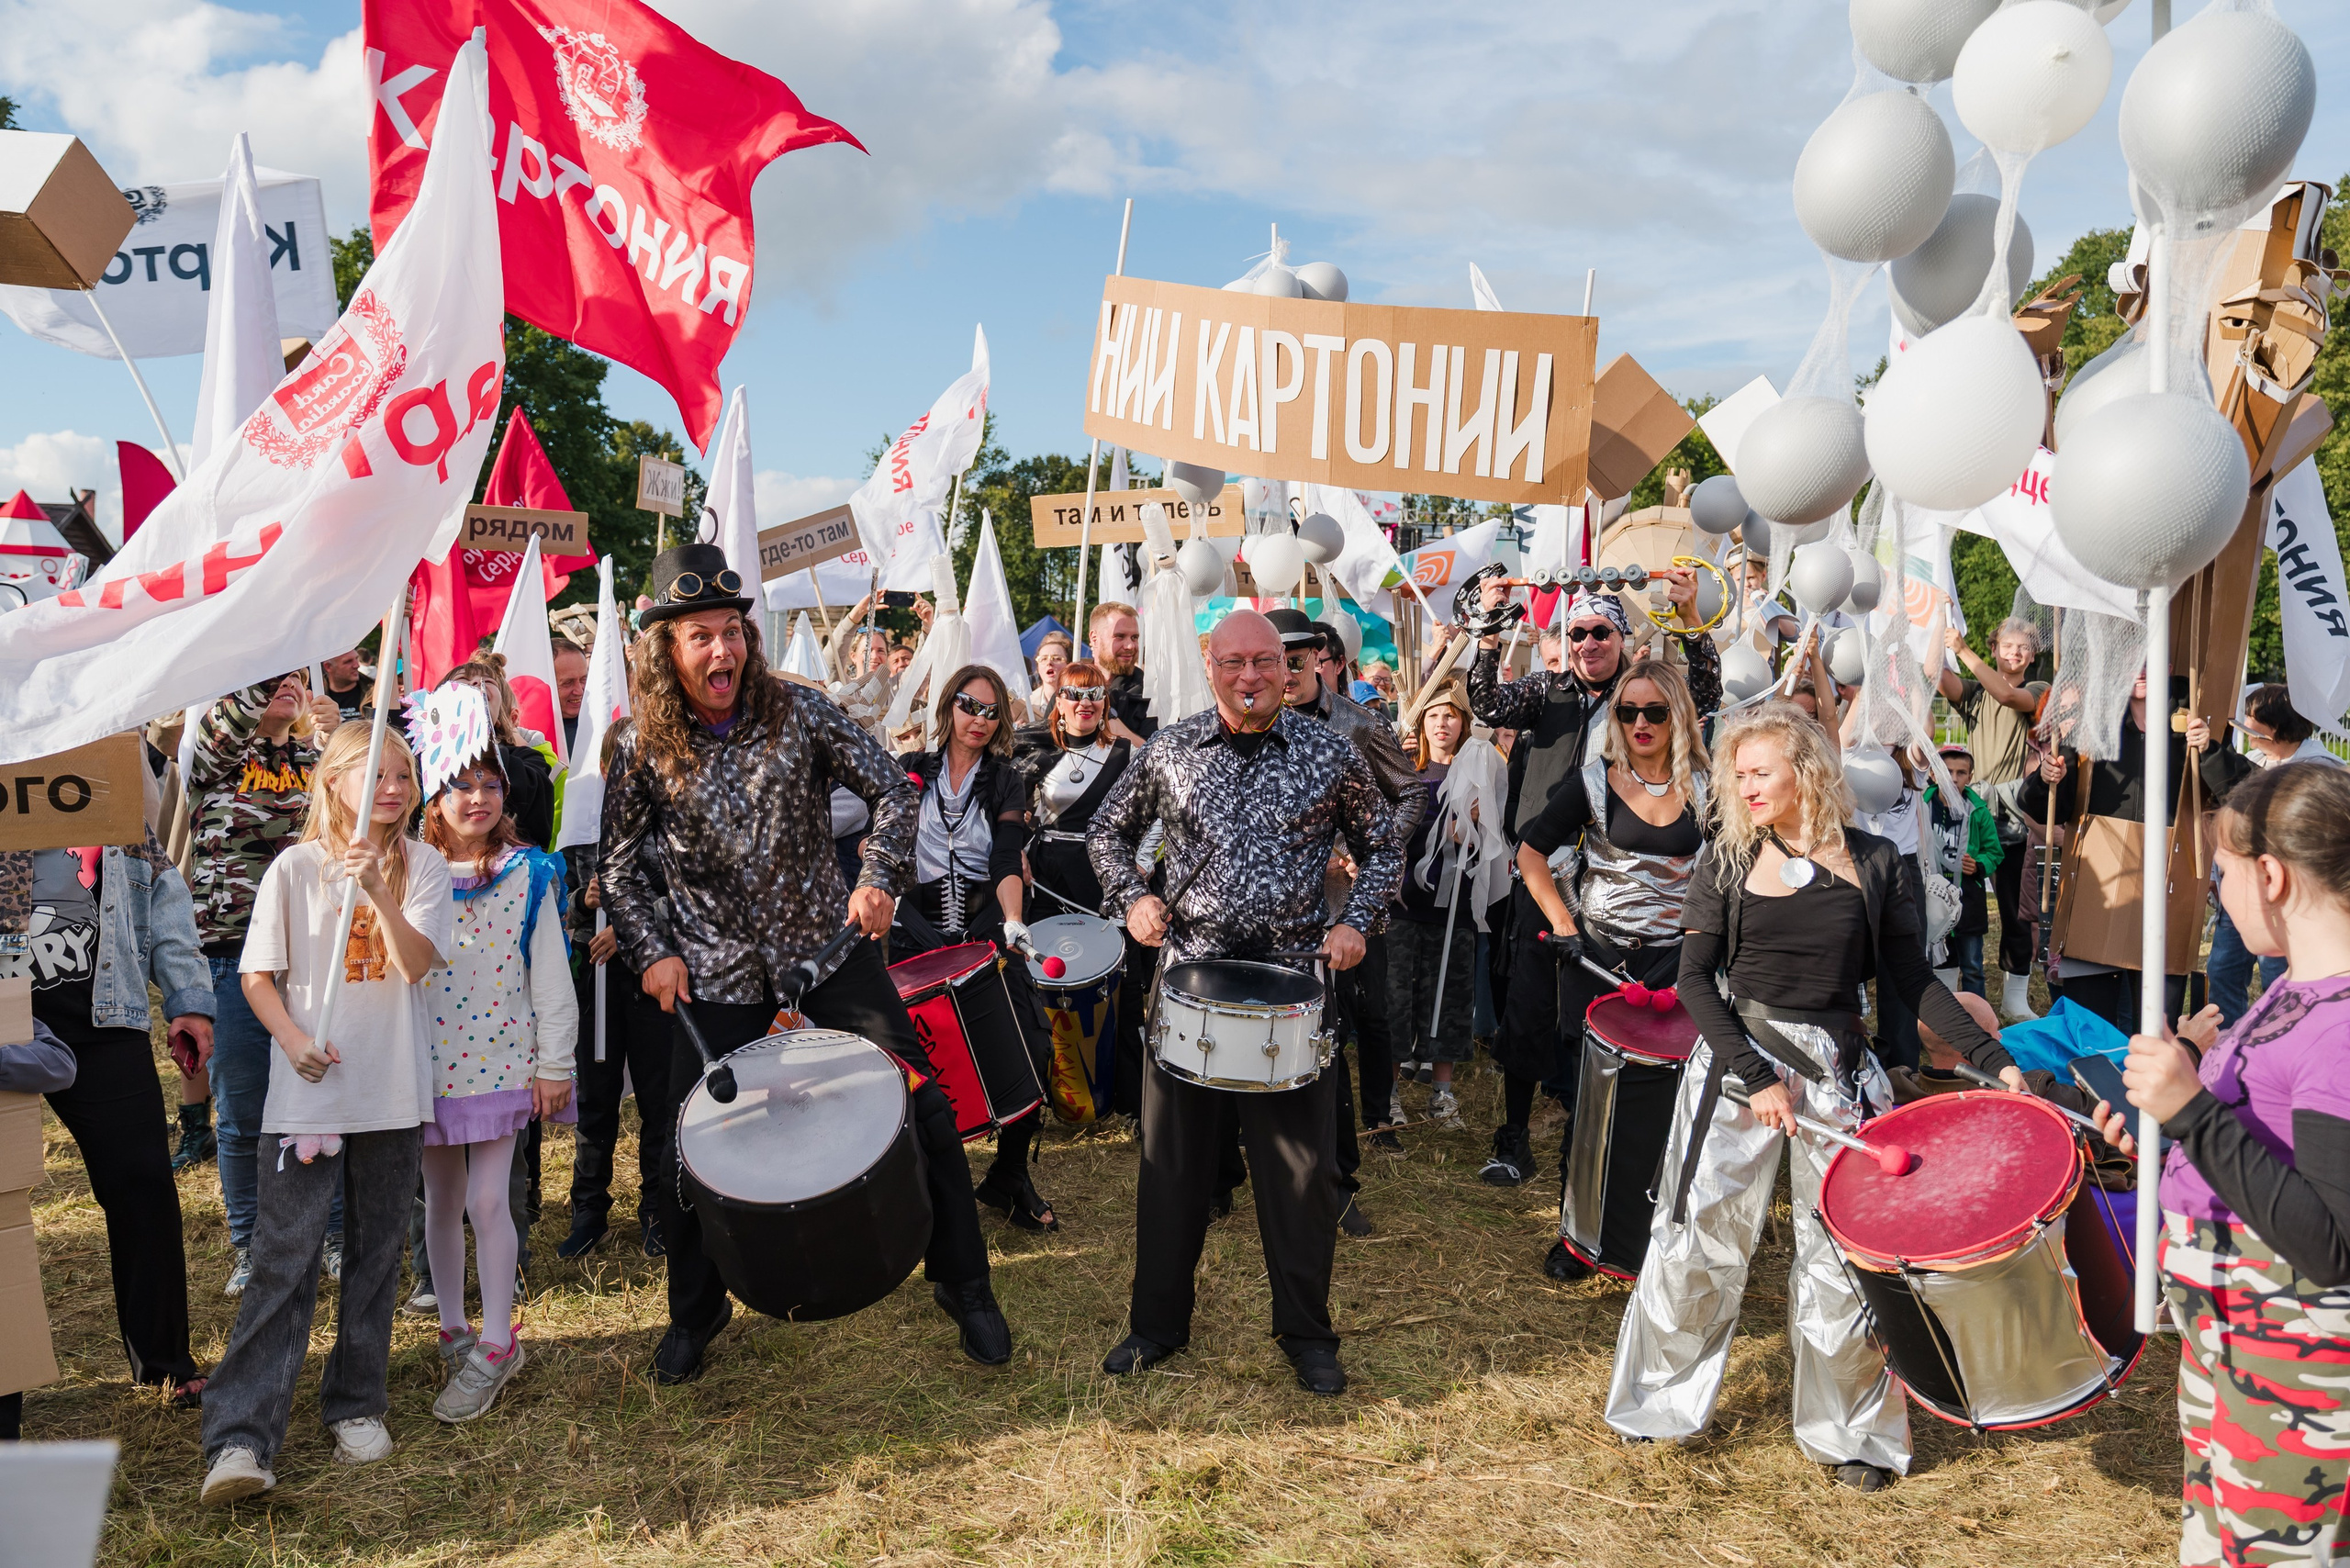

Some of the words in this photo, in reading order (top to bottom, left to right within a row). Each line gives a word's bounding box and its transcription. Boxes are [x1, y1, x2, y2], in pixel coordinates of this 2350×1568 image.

[364, 46, 750, 328] Кртония
[1091, 300, 1183, 431] НИИ
[1193, 319, 1554, 484] КАРТОНИИ
[645, 469, 681, 501] Жжи!
[468, 516, 575, 543] рядом
[1111, 504, 1125, 522] и
[759, 532, 816, 567] где-то
[817, 521, 850, 545] там
[0, 774, 92, 814] го
